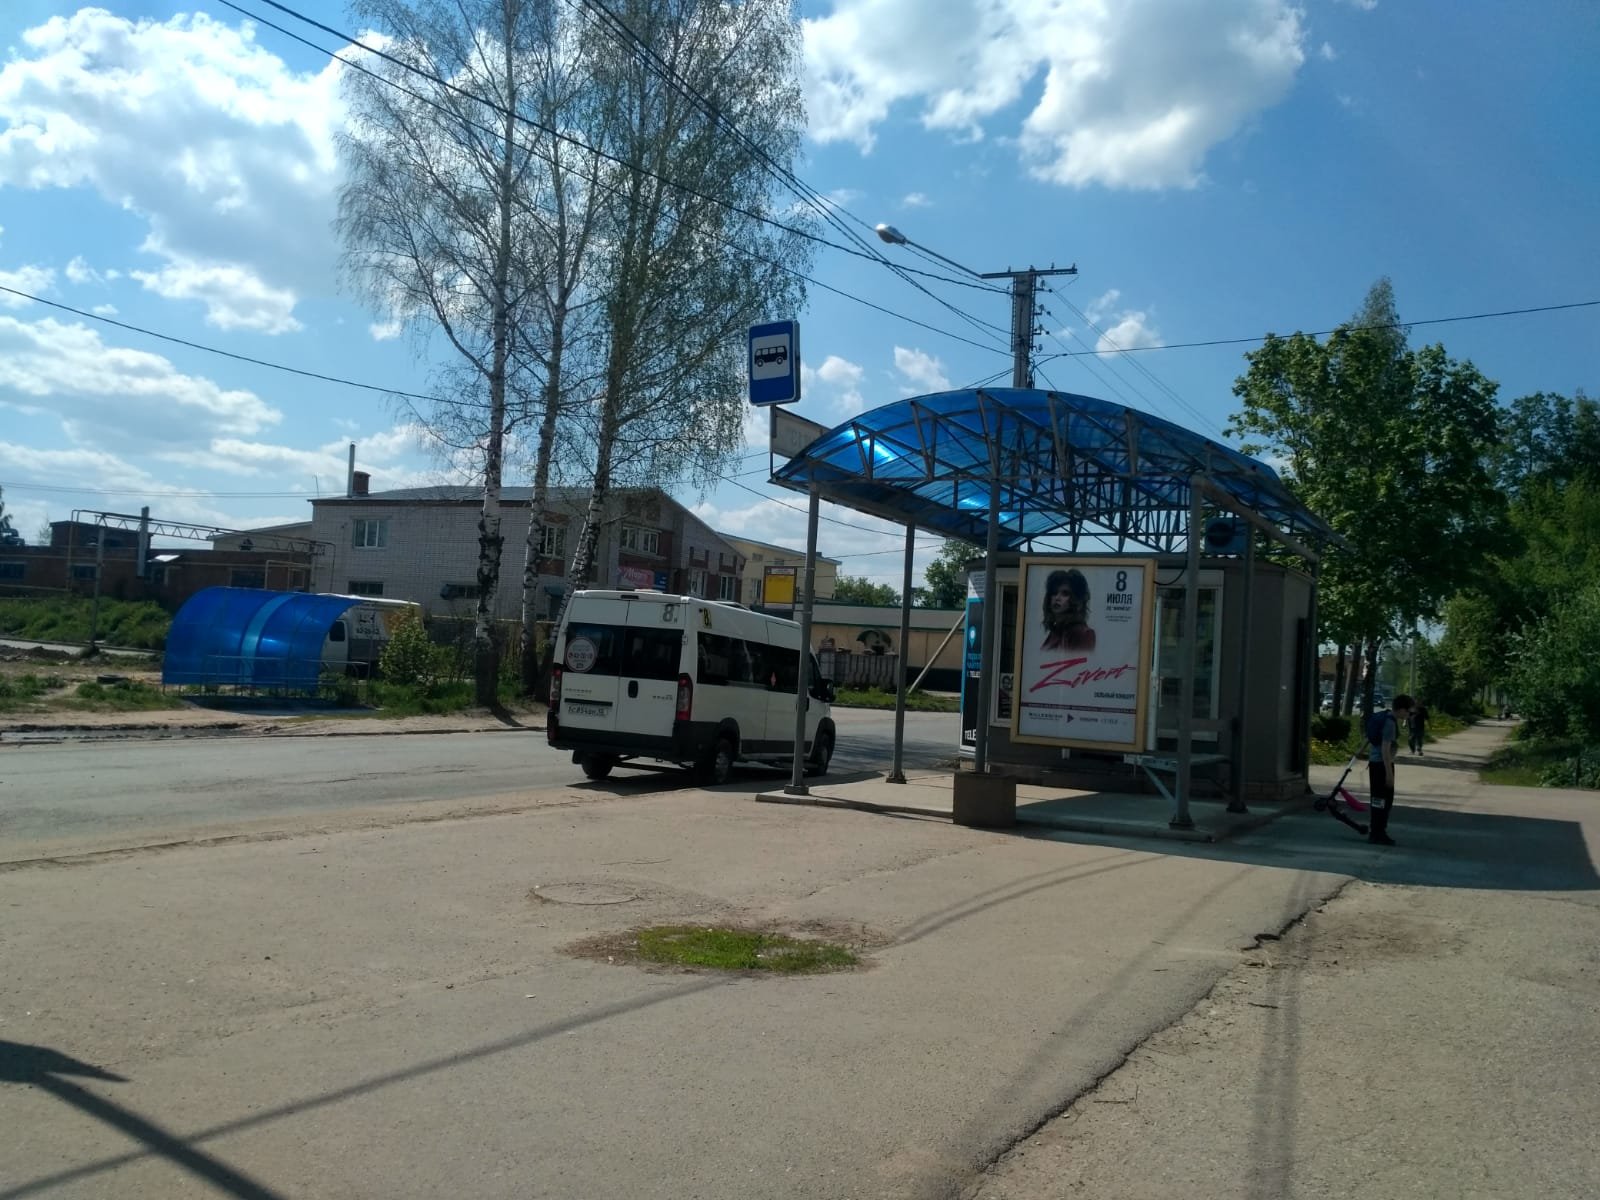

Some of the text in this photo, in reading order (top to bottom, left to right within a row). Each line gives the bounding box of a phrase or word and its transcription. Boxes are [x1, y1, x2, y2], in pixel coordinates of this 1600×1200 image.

[1115, 570, 1128, 592] 8
[1106, 593, 1133, 605] ИЮЛЯ
[662, 604, 673, 622] 8
[1029, 657, 1137, 693] Zivert
